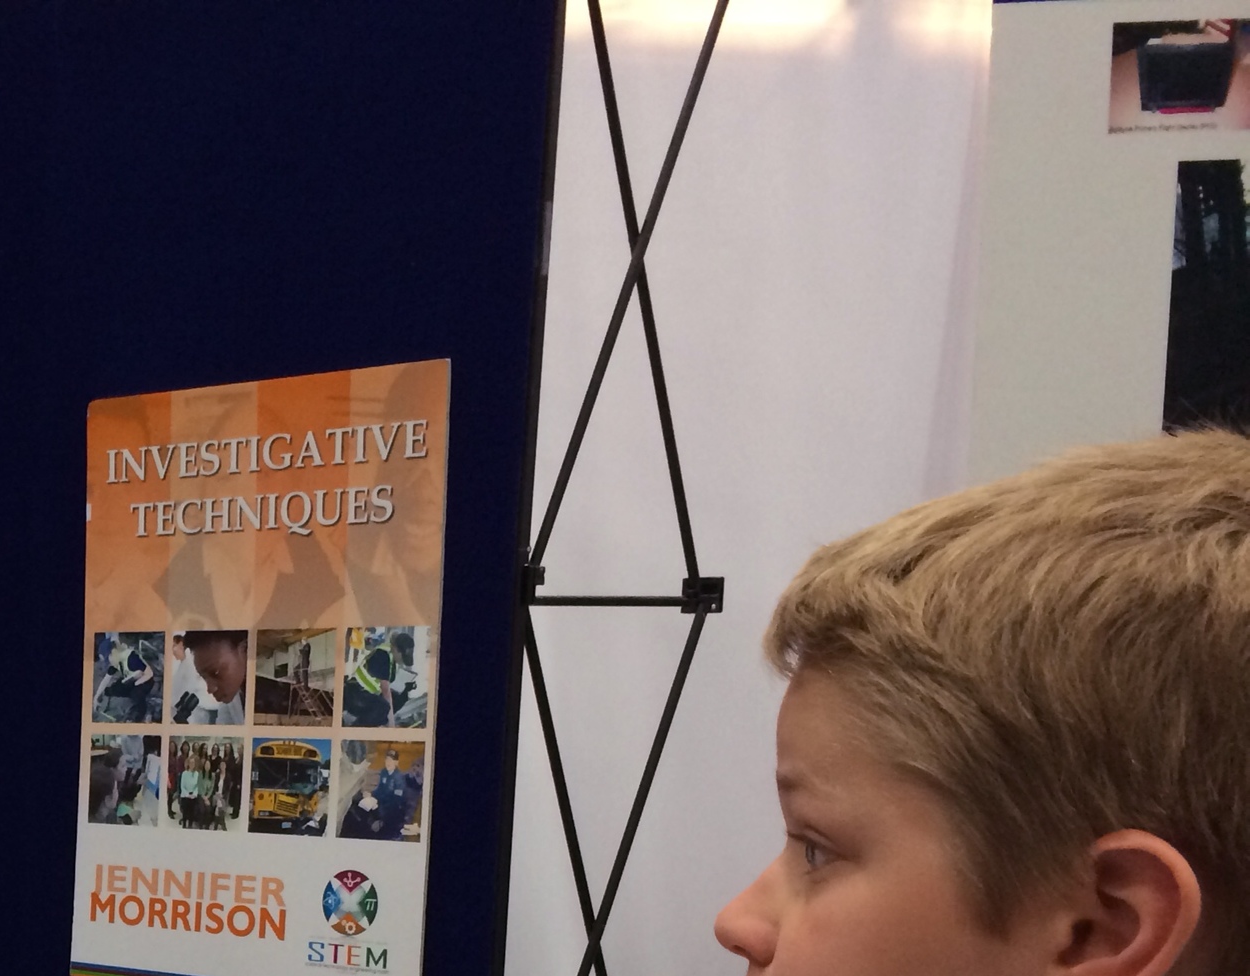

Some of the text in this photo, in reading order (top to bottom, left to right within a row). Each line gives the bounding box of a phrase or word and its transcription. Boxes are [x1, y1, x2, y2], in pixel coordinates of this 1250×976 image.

[105, 419, 430, 485] INVESTIGATIVE
[130, 485, 395, 538] TECHNIQUES
[93, 864, 287, 907] JENNIFER
[89, 891, 287, 941] MORRISON
[307, 941, 388, 970] STEM
